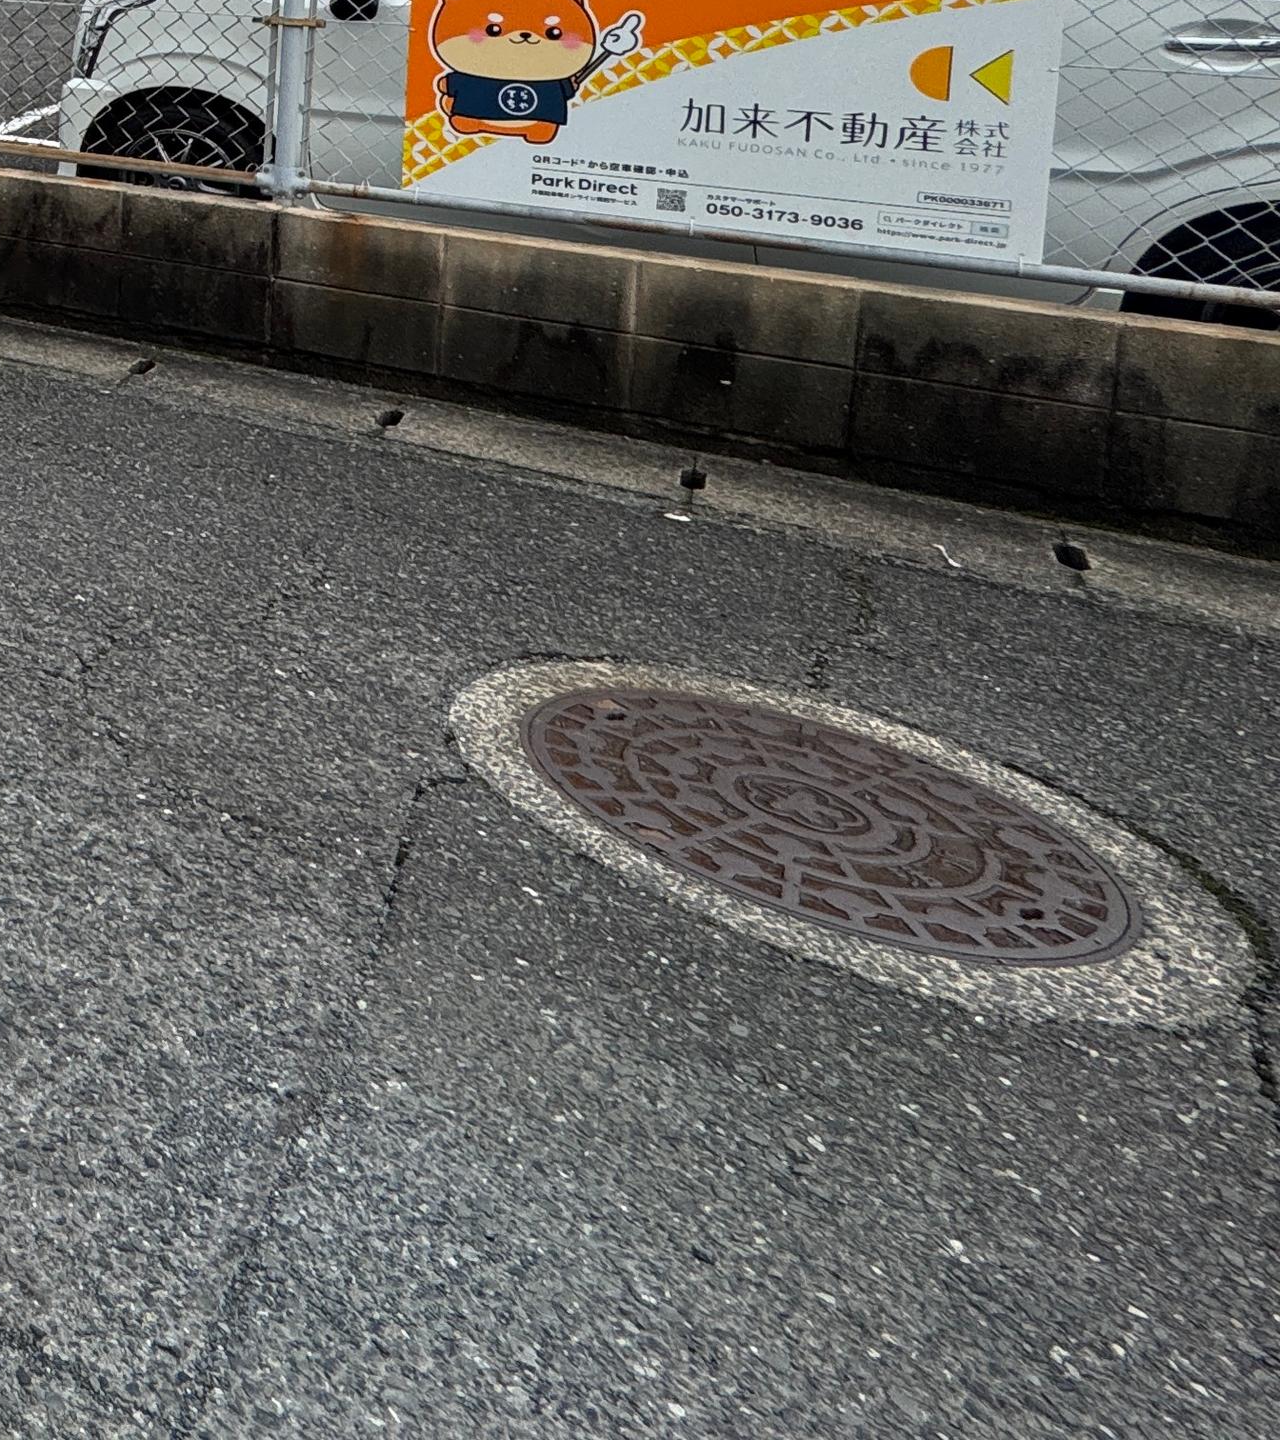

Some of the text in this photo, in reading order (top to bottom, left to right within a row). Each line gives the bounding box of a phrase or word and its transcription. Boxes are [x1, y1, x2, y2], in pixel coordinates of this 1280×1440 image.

[680, 98, 947, 154] 加来不動産
[954, 119, 1010, 140] 株式
[677, 137, 721, 150] KAKU
[728, 141, 807, 158] FUDOSAN
[902, 158, 951, 171] since
[960, 161, 1005, 175] 1977
[953, 137, 1008, 158] 会社
[531, 173, 639, 196] Park Direct
[706, 203, 864, 231] 050-3173-9036
